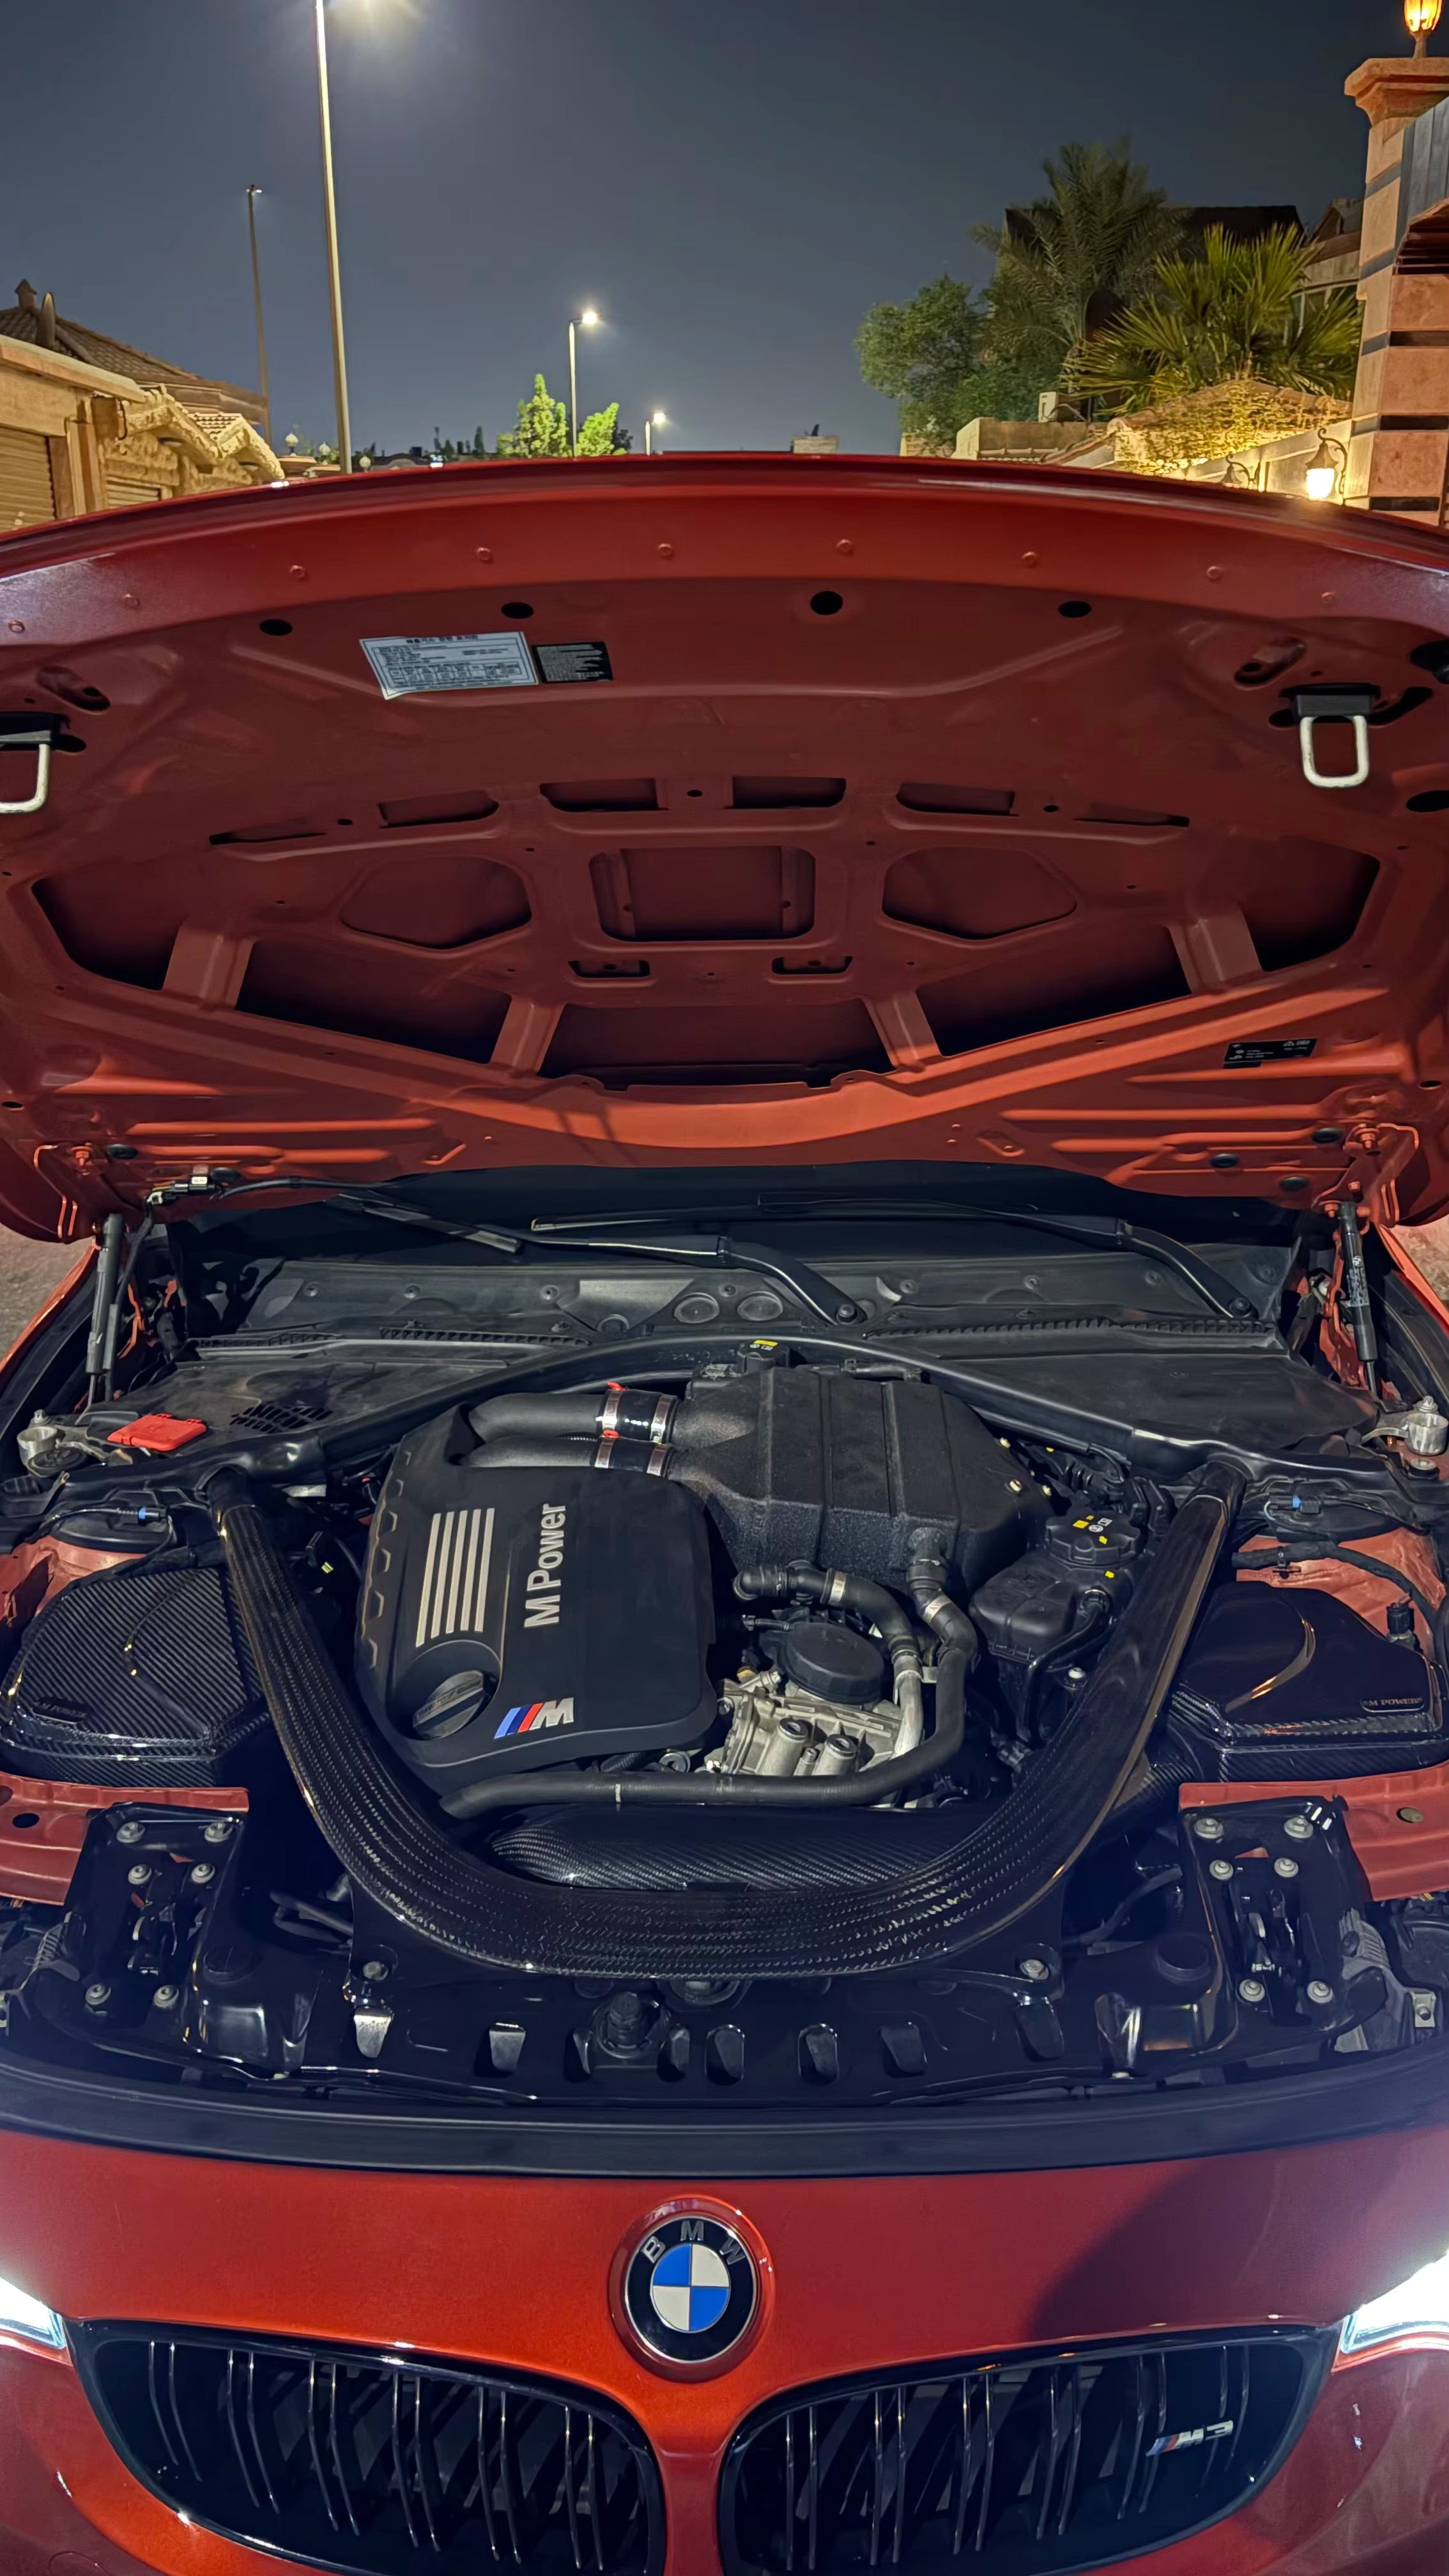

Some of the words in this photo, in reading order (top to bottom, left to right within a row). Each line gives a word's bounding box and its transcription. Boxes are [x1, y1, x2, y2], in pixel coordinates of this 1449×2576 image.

[526, 1503, 566, 1591] Power
[524, 1595, 561, 1628] M
[529, 1697, 574, 1731] M
[641, 2220, 746, 2265] BMW
[1174, 2419, 1234, 2450] M3
